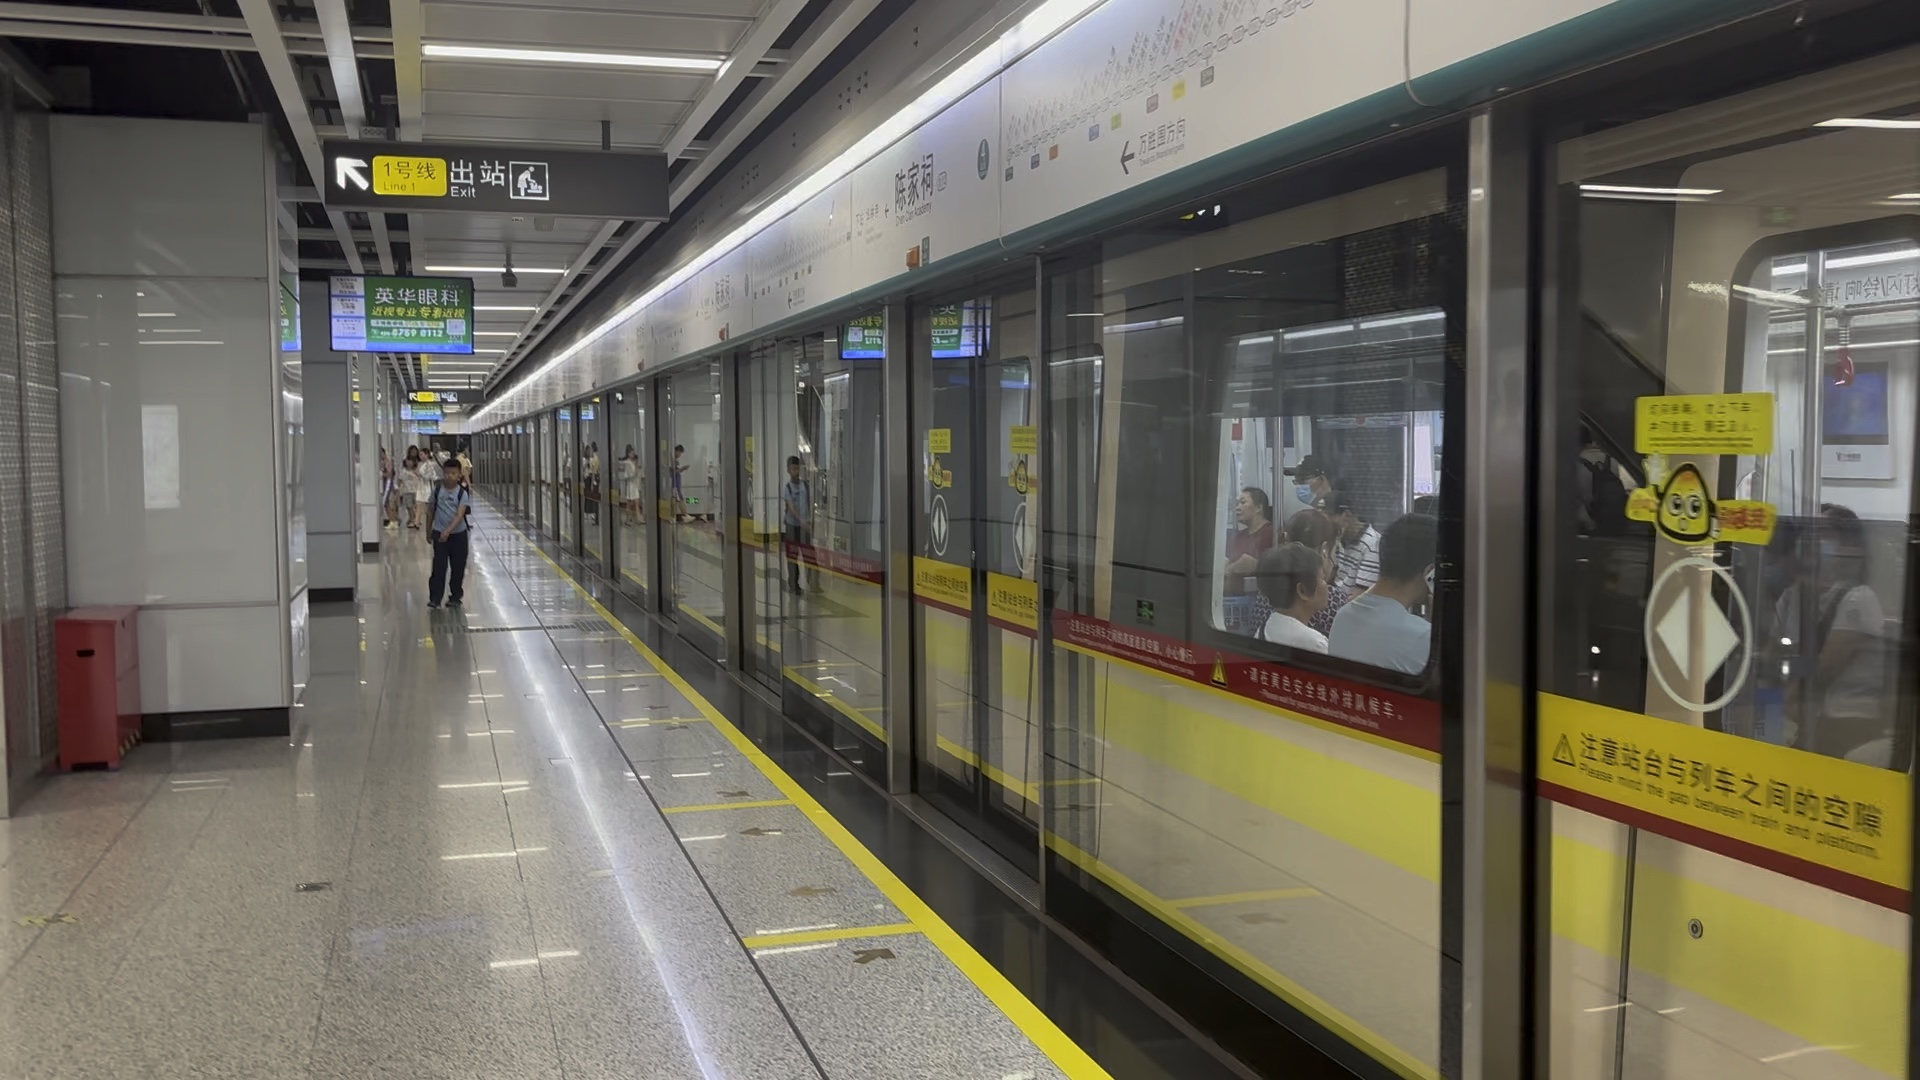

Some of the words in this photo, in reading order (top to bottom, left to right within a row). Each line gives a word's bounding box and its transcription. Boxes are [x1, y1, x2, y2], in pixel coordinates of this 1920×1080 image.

[383, 161, 436, 180] 1号线
[450, 159, 506, 187] 出站
[383, 182, 407, 192] Line
[410, 182, 416, 191] 1
[450, 186, 476, 198] Exit
[895, 153, 934, 213] 陈家祠
[374, 287, 461, 306] 英华眼科
[371, 306, 417, 318] 近视专业
[1580, 732, 1882, 837] 注意站台与列车之间的空隙
[1579, 762, 1614, 783] Please
[1646, 783, 1664, 798] the
[1667, 791, 1690, 805] gap
[1694, 796, 1745, 820] between
[1751, 812, 1779, 831] train
[1784, 823, 1811, 840] and
